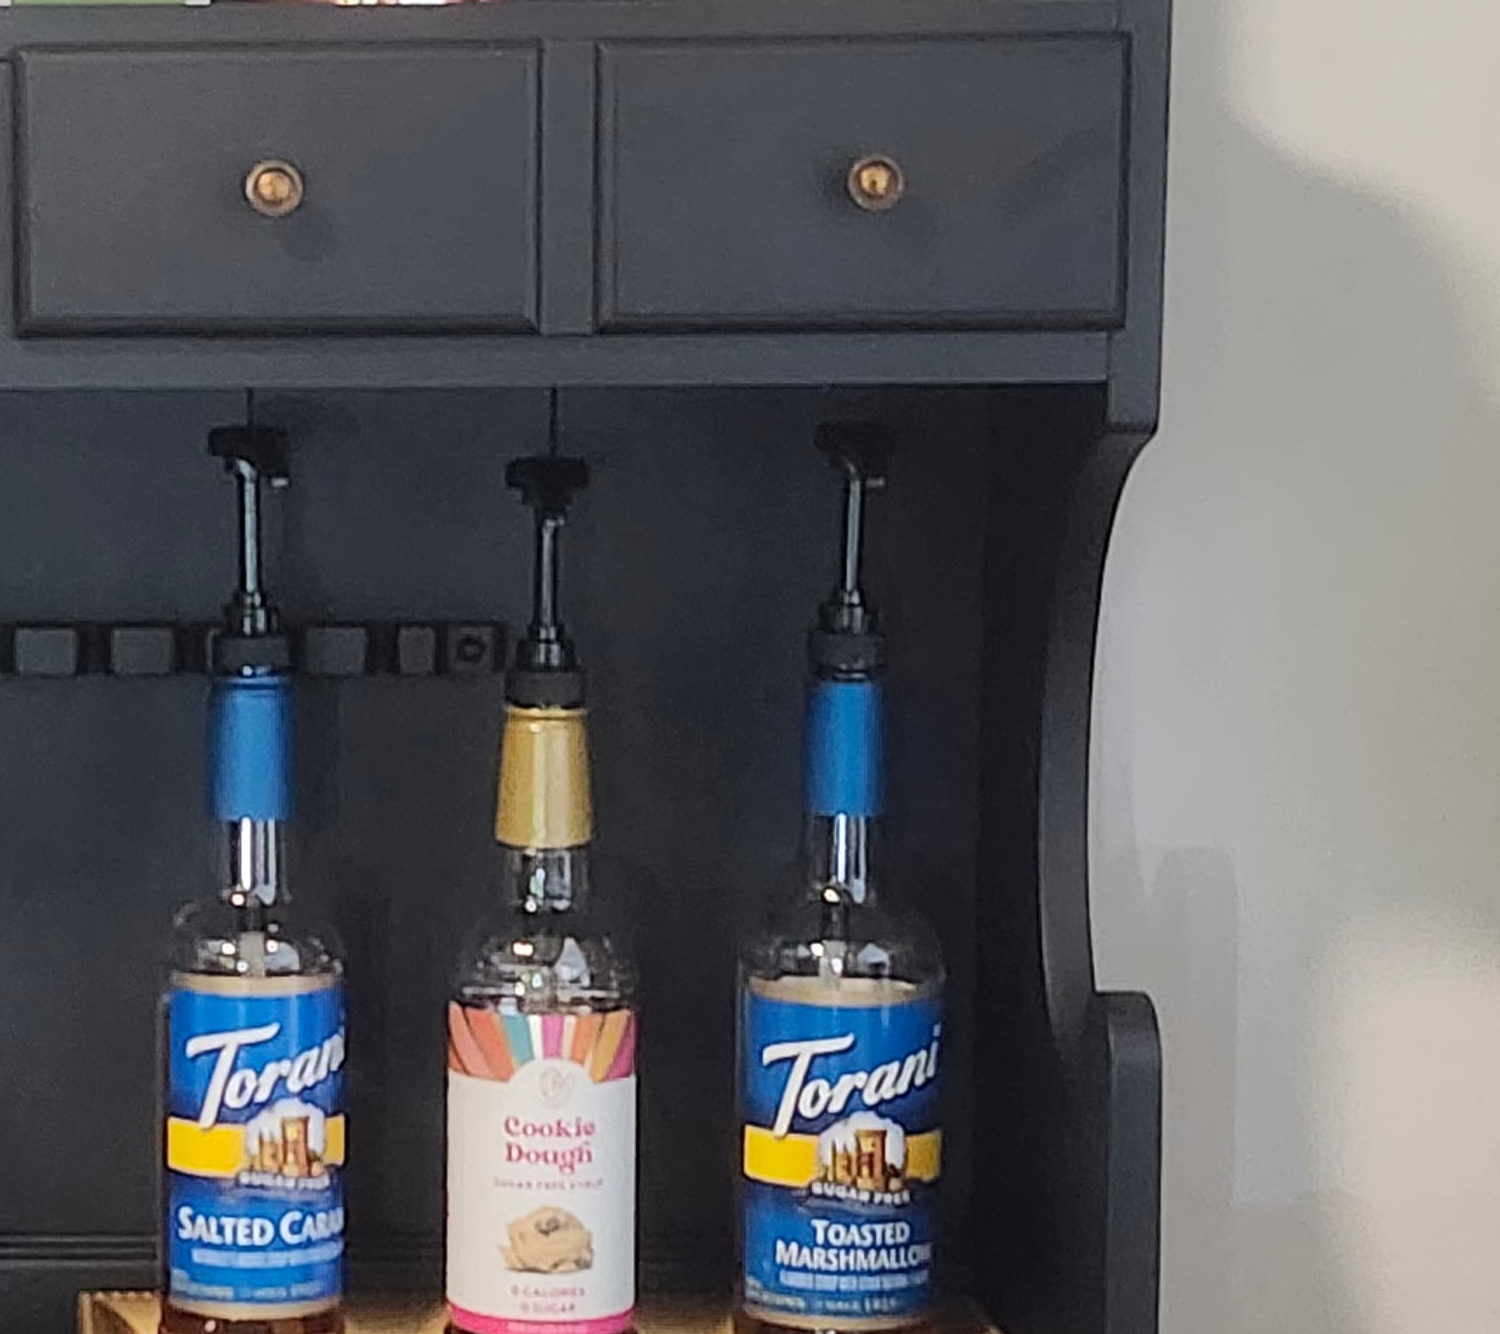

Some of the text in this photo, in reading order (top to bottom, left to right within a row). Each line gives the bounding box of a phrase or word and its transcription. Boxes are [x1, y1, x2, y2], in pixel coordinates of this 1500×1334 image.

[185, 1021, 345, 1132] Toran
[762, 1022, 941, 1140] Torani
[504, 1115, 596, 1138] Cookie
[505, 1140, 593, 1175] Dough
[178, 1205, 345, 1247] SALTED CARA
[810, 1218, 911, 1248] TOASTED
